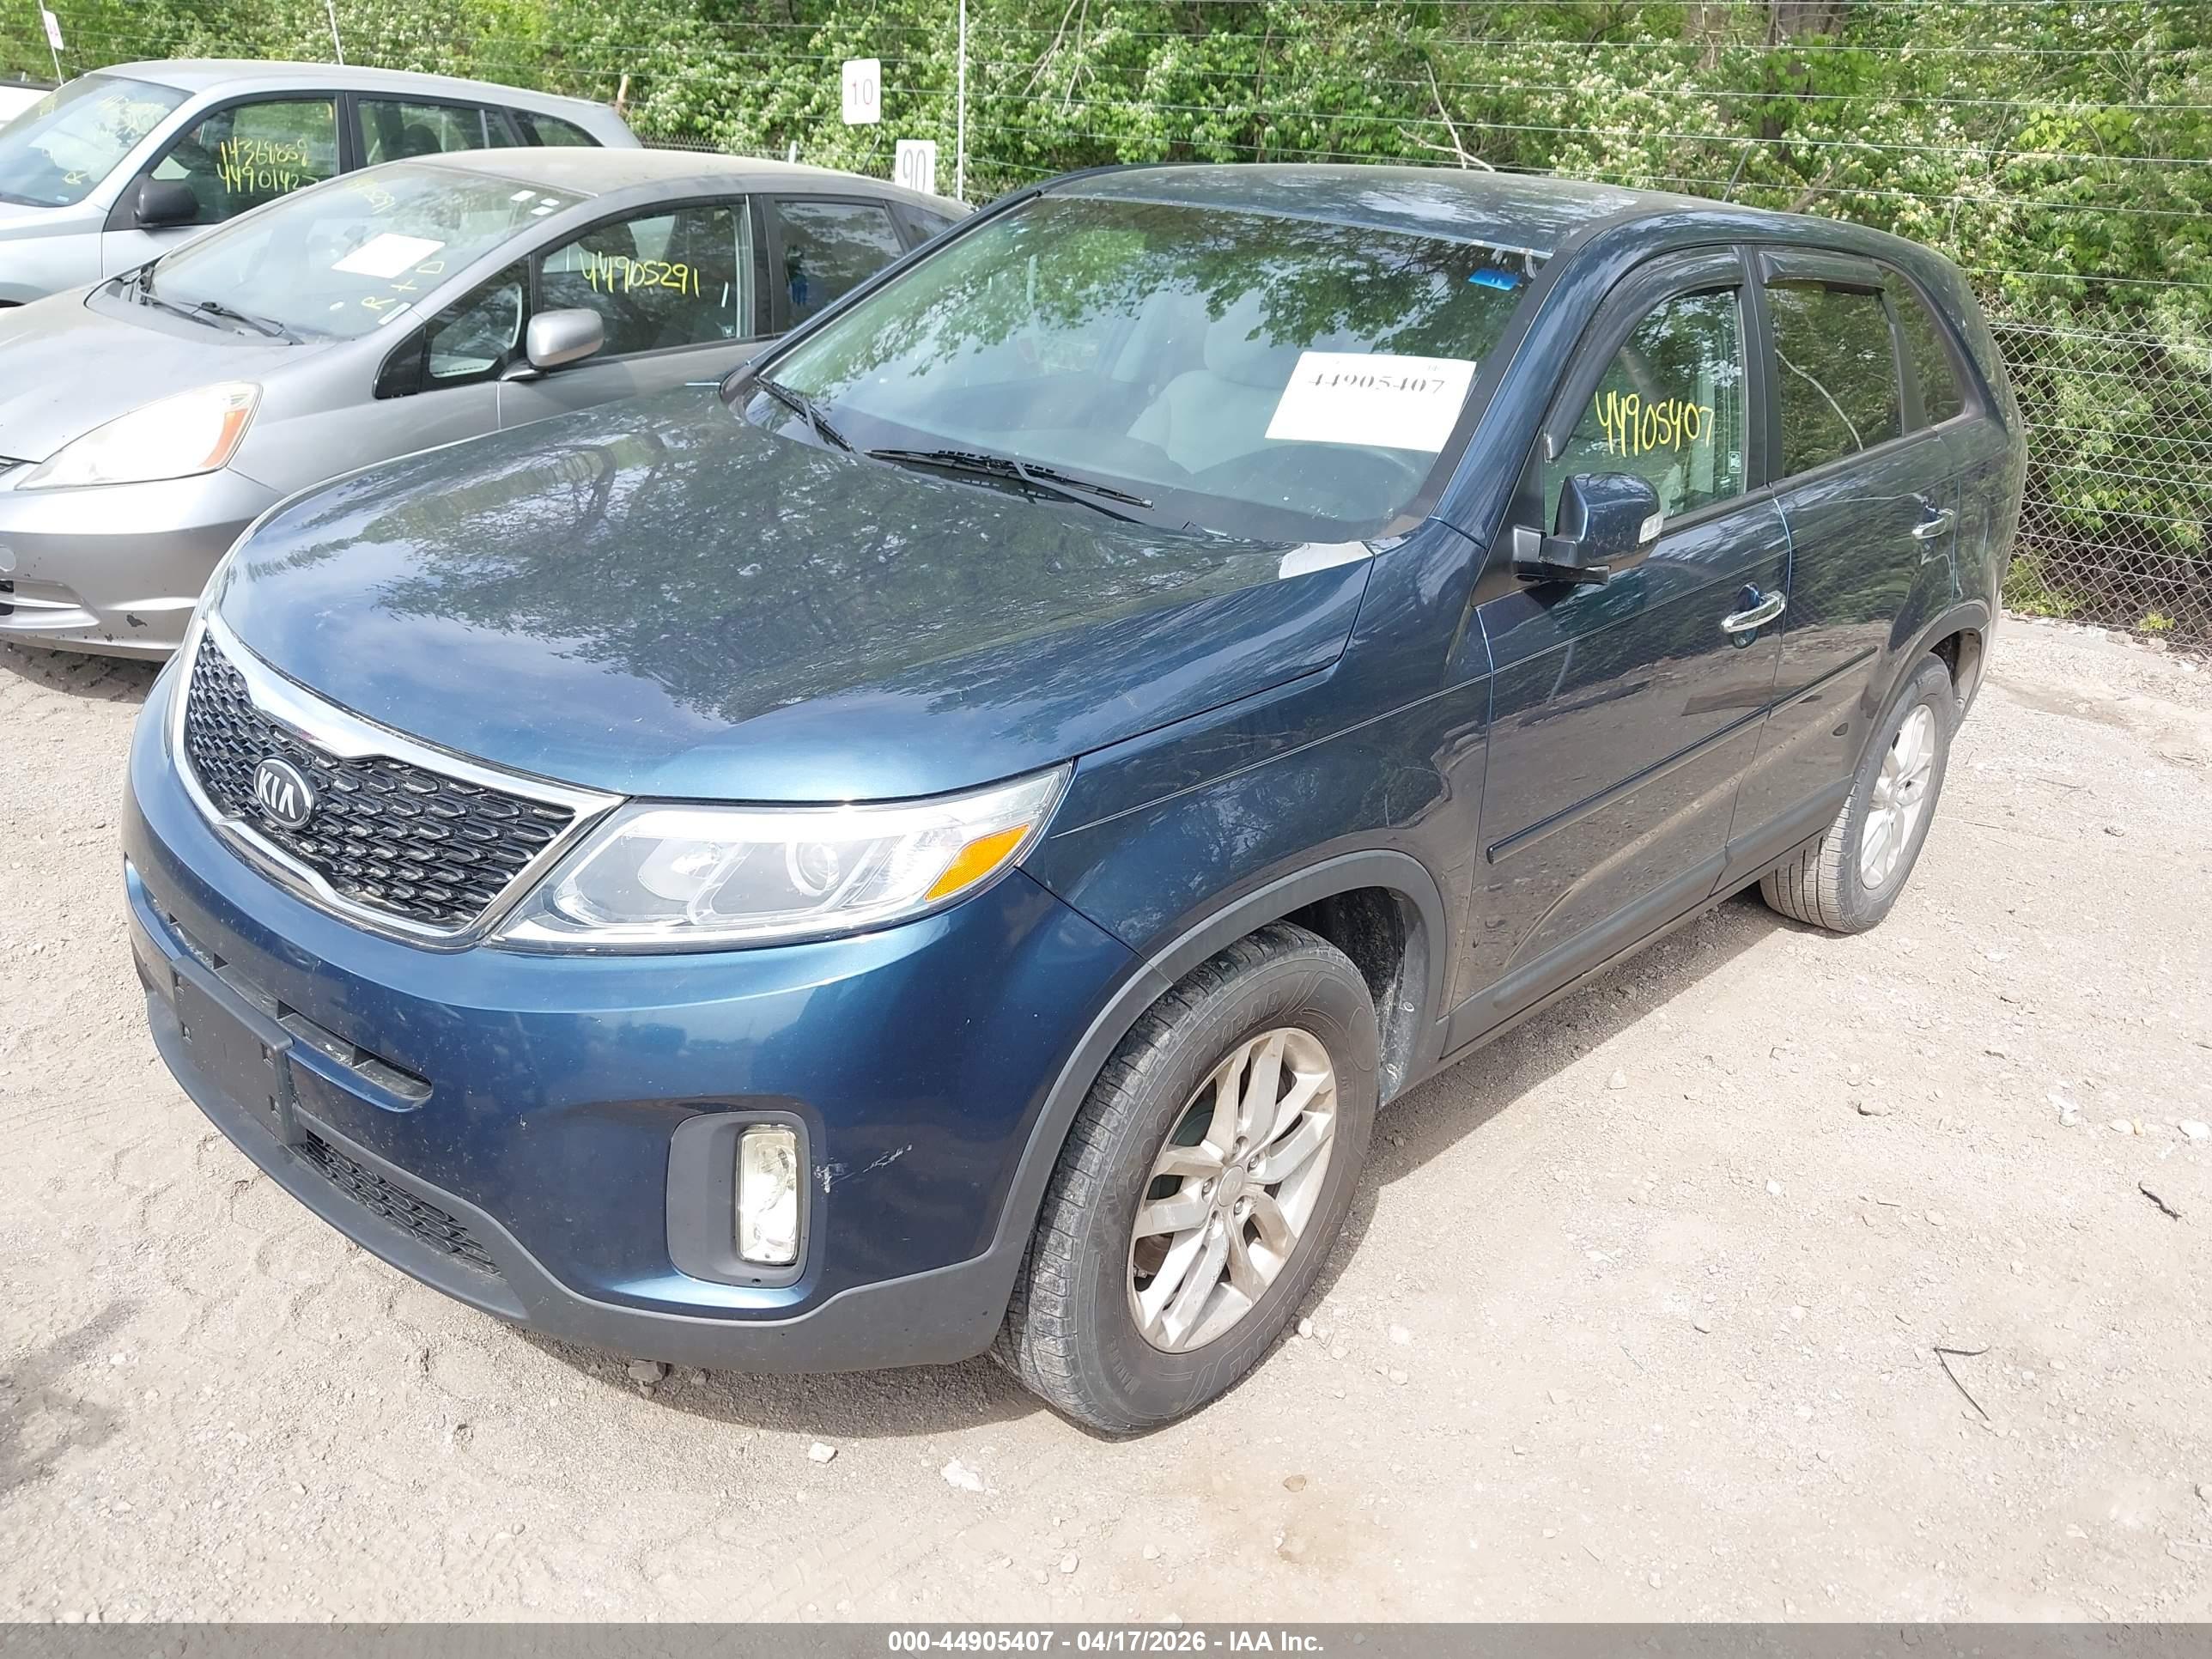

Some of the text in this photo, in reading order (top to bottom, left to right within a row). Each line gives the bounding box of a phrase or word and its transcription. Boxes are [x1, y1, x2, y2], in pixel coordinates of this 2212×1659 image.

[852, 79, 873, 105] 10
[903, 149, 927, 191] 90
[579, 251, 701, 298] 44905291
[1308, 373, 1446, 394] 44905407
[1595, 390, 1715, 458] 44905407
[258, 766, 296, 820] KIA
